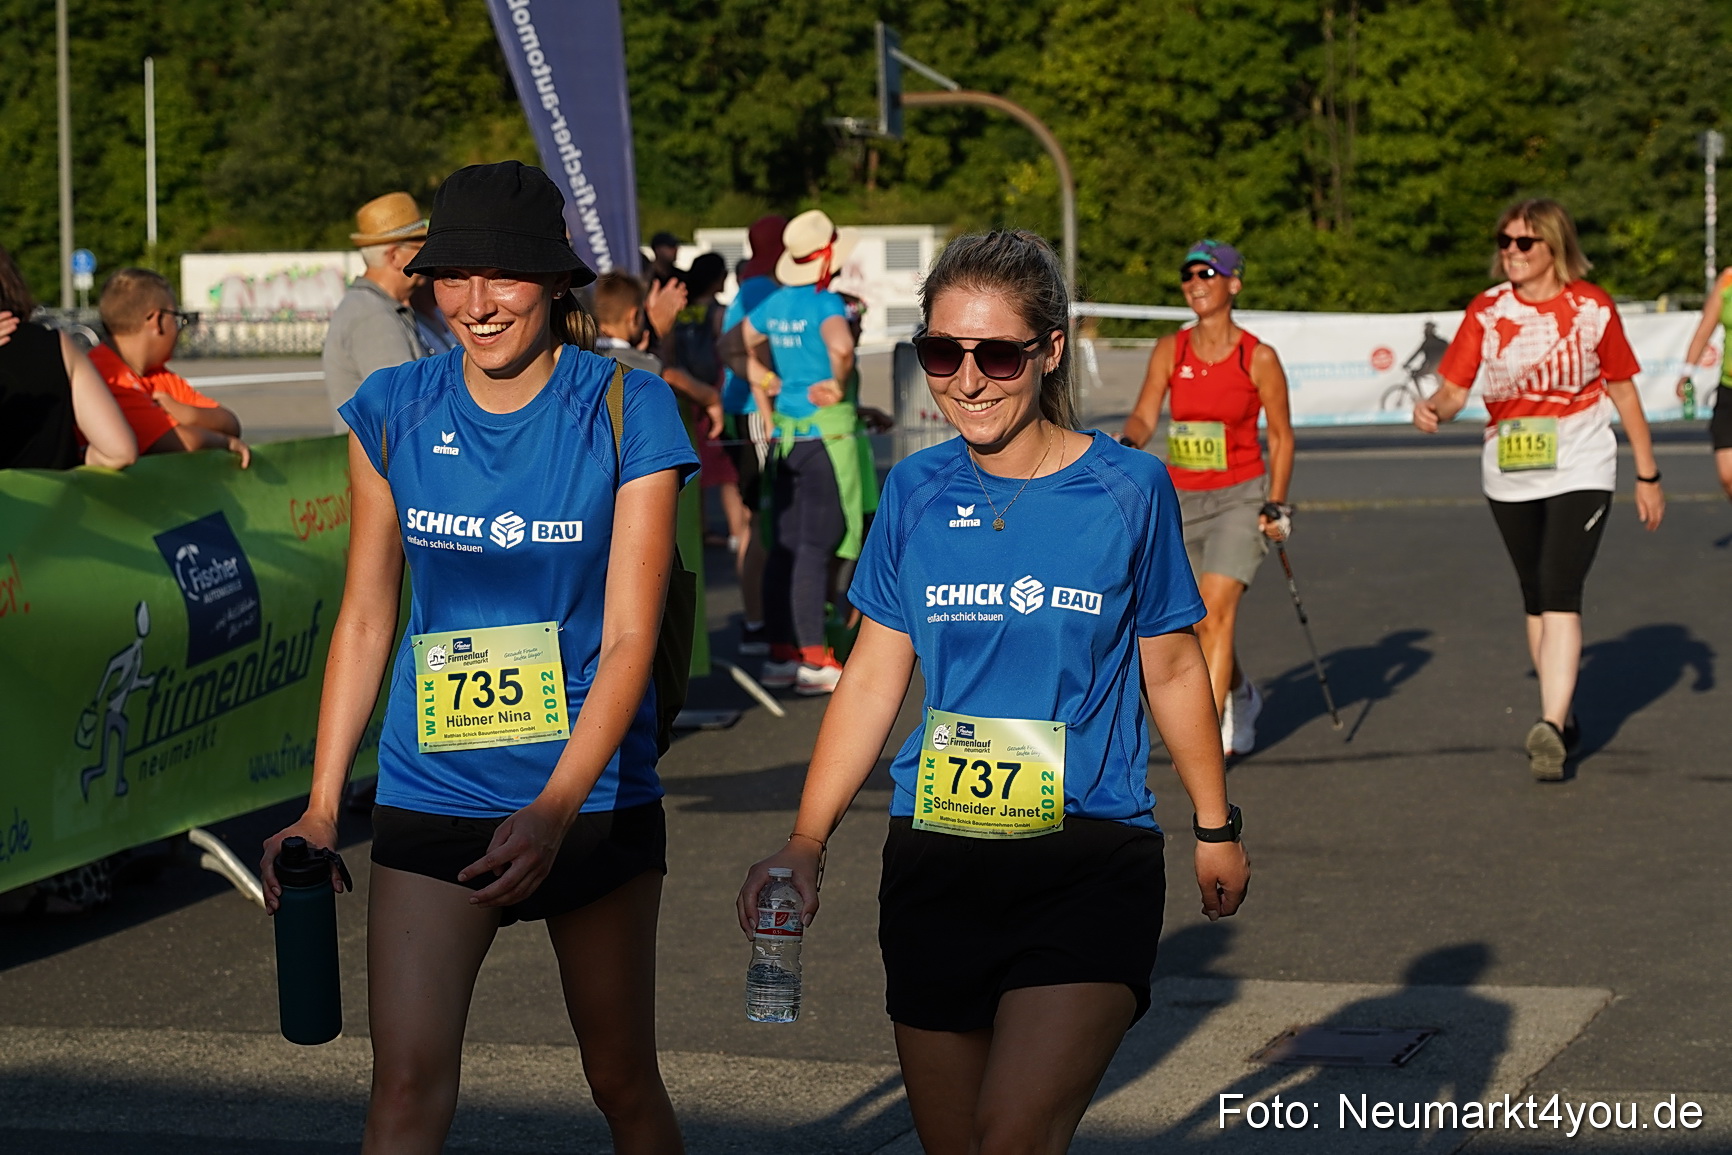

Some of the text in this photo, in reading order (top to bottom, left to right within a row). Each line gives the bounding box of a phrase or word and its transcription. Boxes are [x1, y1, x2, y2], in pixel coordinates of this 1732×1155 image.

[432, 445, 460, 456] erima
[1174, 438, 1214, 455] 1110
[1506, 433, 1546, 452] 1115
[407, 508, 577, 540] SCHICK BAU
[949, 518, 981, 528] erima
[430, 540, 456, 551] schick
[456, 542, 483, 553] bauen
[188, 556, 239, 593] Fischer
[926, 584, 1098, 611] SCHICK BAU
[950, 612, 977, 622] schick
[977, 612, 1004, 622] bauen
[448, 649, 489, 663] Firmenlauf
[143, 600, 323, 744] firmenlauf
[448, 668, 523, 711] 735
[541, 670, 559, 724] 2022
[424, 680, 437, 736] WALK
[446, 710, 532, 728] Hübner Nina
[950, 737, 991, 748] Firmenlauf
[923, 757, 935, 814] WALK
[948, 756, 1021, 799] 737
[934, 796, 1041, 818] Schneider Janet
[1041, 770, 1055, 822] 2022
